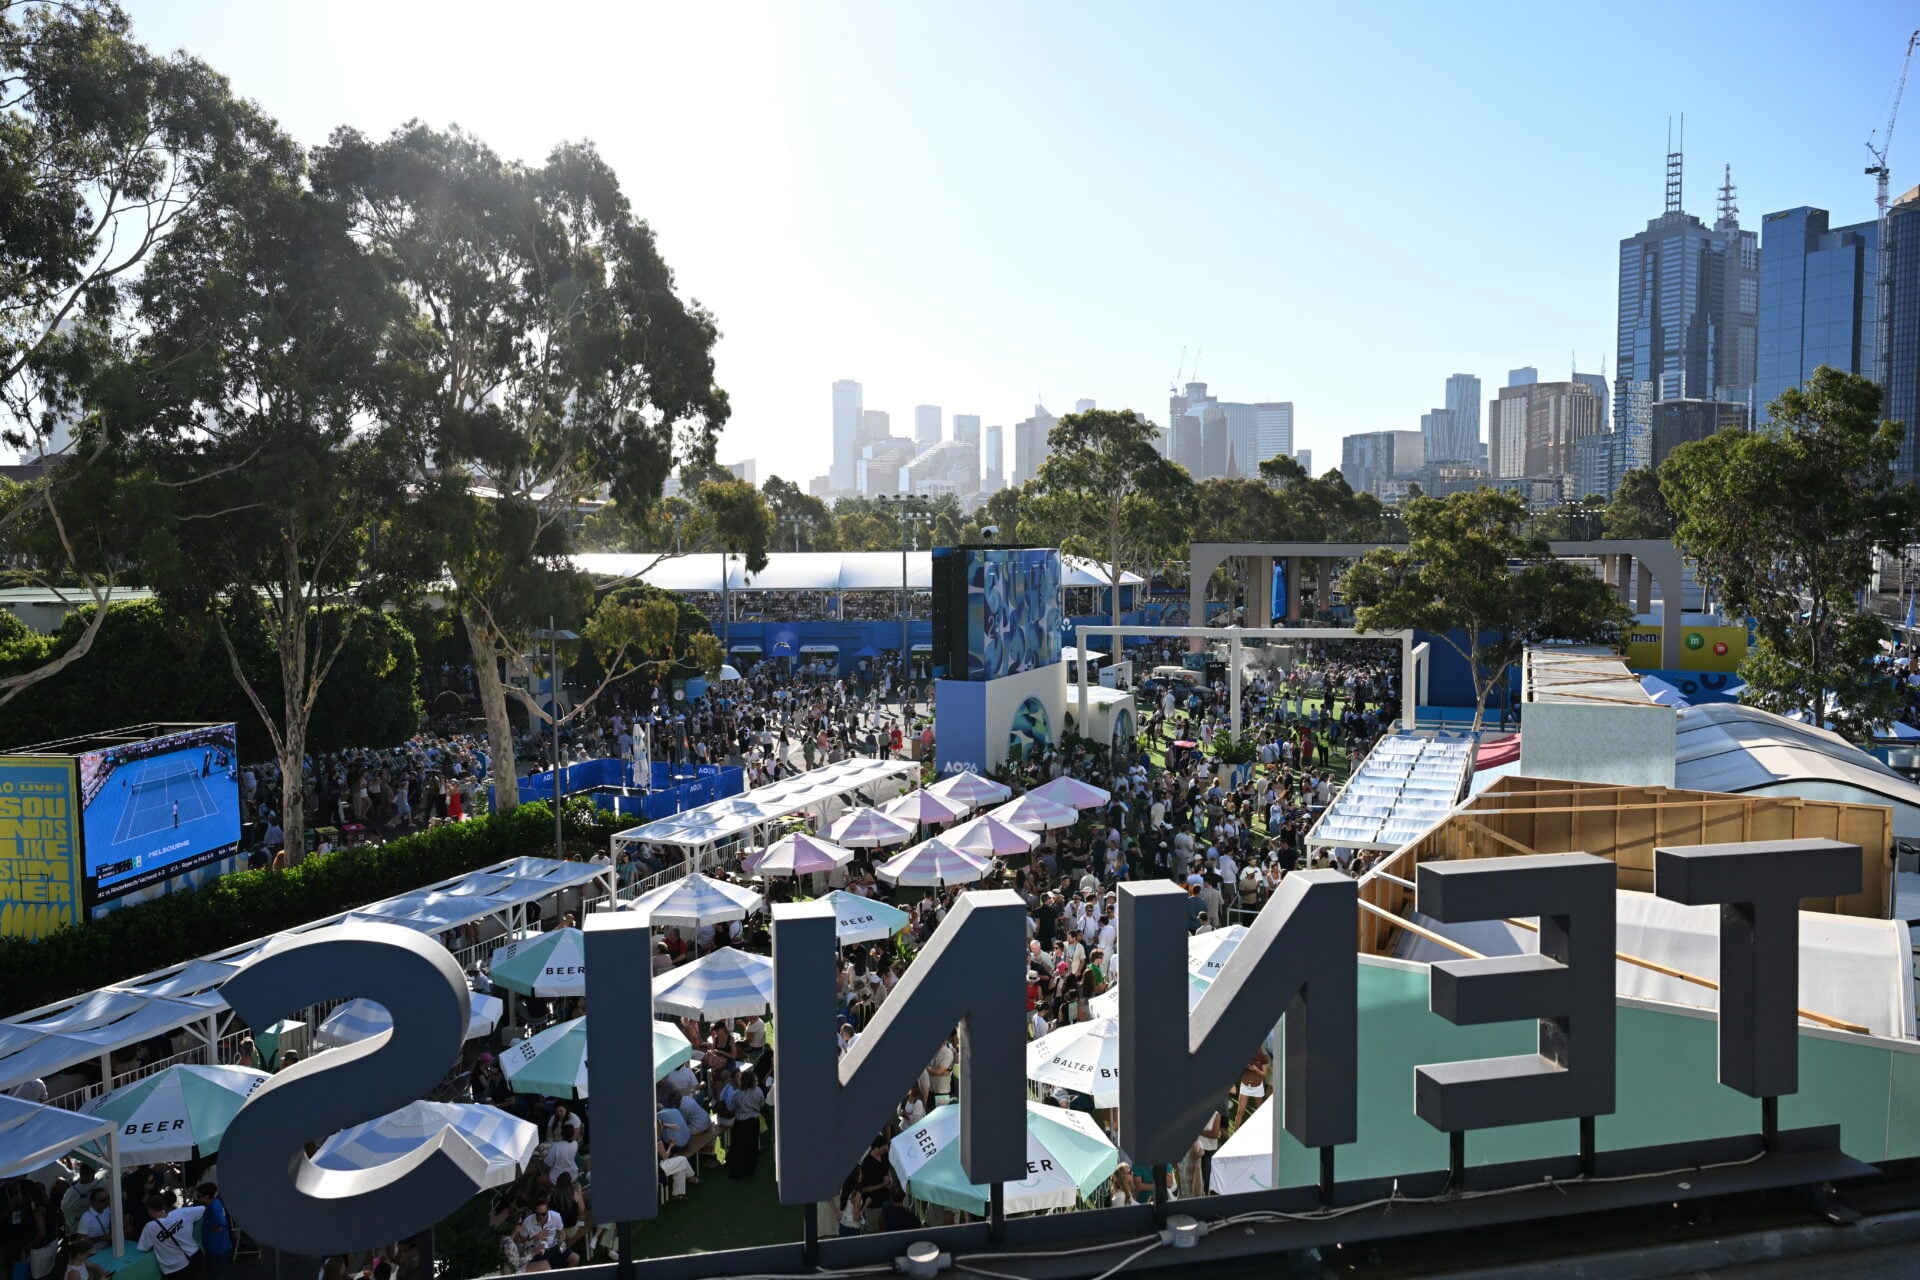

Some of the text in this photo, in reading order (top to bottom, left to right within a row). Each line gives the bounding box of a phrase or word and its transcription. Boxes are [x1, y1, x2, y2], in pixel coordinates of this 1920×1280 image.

[698, 767, 716, 775] AO26
[944, 761, 978, 774] AO26
[543, 772, 555, 782] AO2
[19, 783, 56, 792] LIVE
[0, 796, 66, 818] SOU
[0, 819, 67, 839] NDS
[0, 840, 68, 860] LIKE
[148, 840, 191, 858] MELBOURNE
[0, 860, 69, 881] SUM
[0, 881, 70, 903] MER
[839, 915, 875, 927] BEER
[545, 966, 585, 975] BEER
[1052, 1057, 1094, 1073] BALTER
[124, 1119, 185, 1136] BEER
[914, 1128, 937, 1159] BEER
